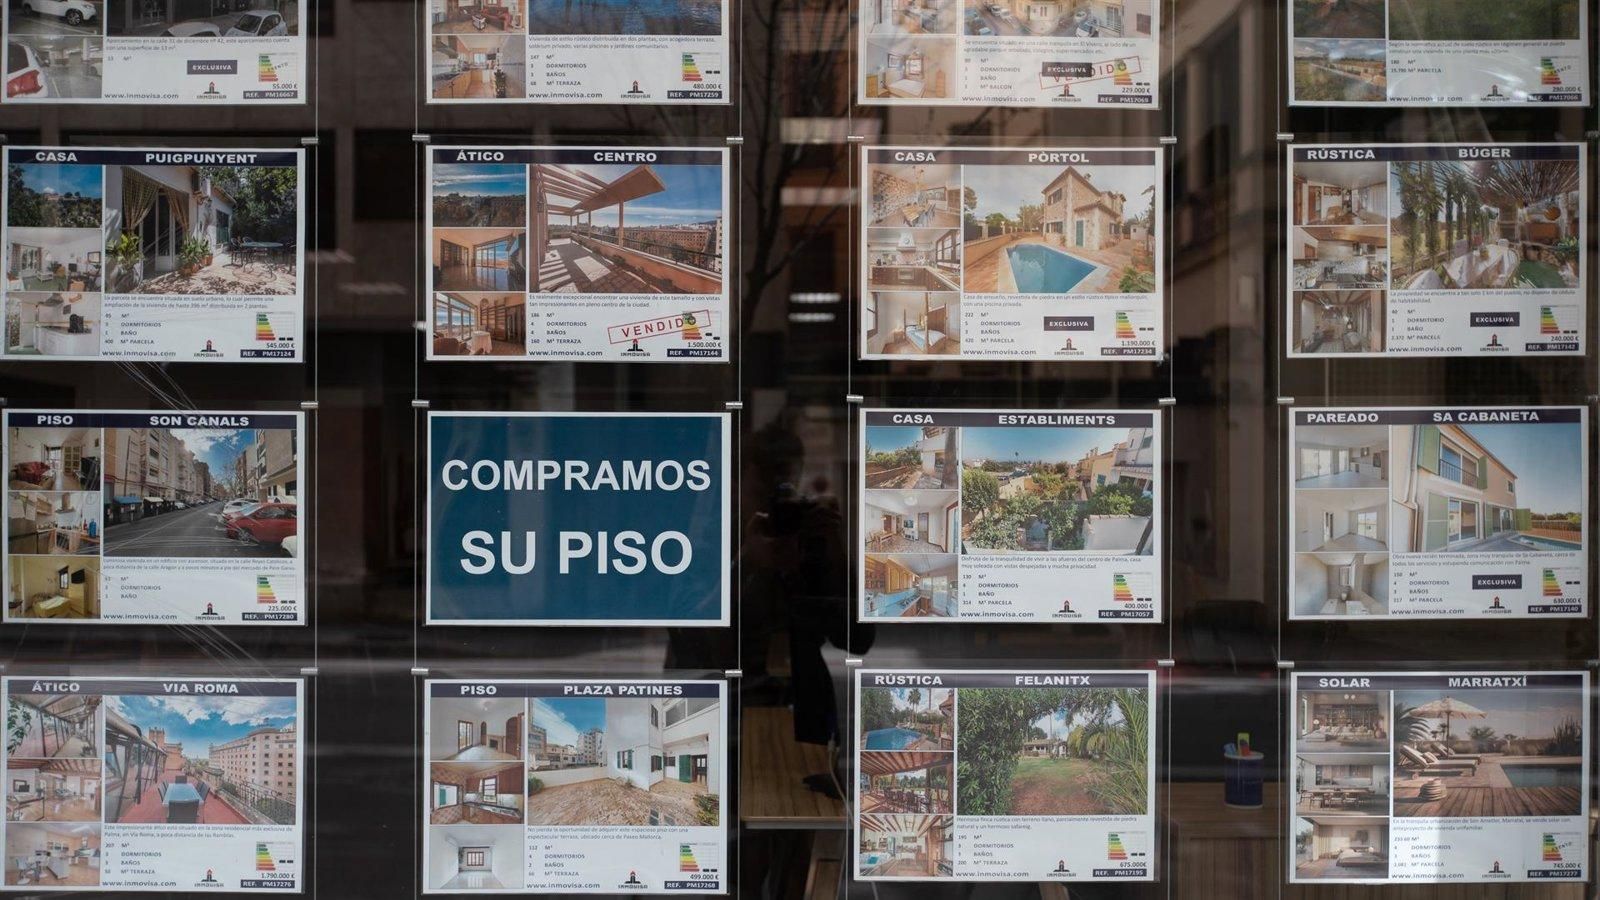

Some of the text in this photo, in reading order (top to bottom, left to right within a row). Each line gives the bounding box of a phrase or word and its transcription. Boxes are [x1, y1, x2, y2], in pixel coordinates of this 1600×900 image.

[456, 149, 504, 161] ÁTICO
[895, 152, 936, 161] CASA
[1028, 150, 1089, 162] PÒRTOL
[1306, 146, 1375, 159] RÚSTICA
[1458, 145, 1510, 158] BÚGER
[36, 152, 77, 162] CASA
[146, 154, 257, 163] PUIGPUNYENT
[594, 152, 657, 162] CENTRO
[622, 316, 696, 338] VENDIDO
[38, 415, 73, 424] PISO
[150, 416, 249, 426] SON CANALS
[893, 414, 934, 424] CASA
[999, 415, 1115, 424] ESTABLIMENTS
[1307, 413, 1378, 422] PAREADO
[1433, 412, 1539, 422] SA CABANETA
[442, 460, 711, 491] COMPRAMOS
[460, 530, 693, 575] SU PISO
[875, 673, 942, 684] RÚSTICA
[1015, 676, 1090, 685] FELANITX
[1319, 678, 1370, 688] SOLAR
[1449, 674, 1526, 687] MARRATXÍ
[32, 679, 82, 692] ÁTICO
[163, 683, 238, 693] VIA ROMA
[461, 686, 496, 694] PISO
[564, 686, 682, 695] PLAZA PATINES
